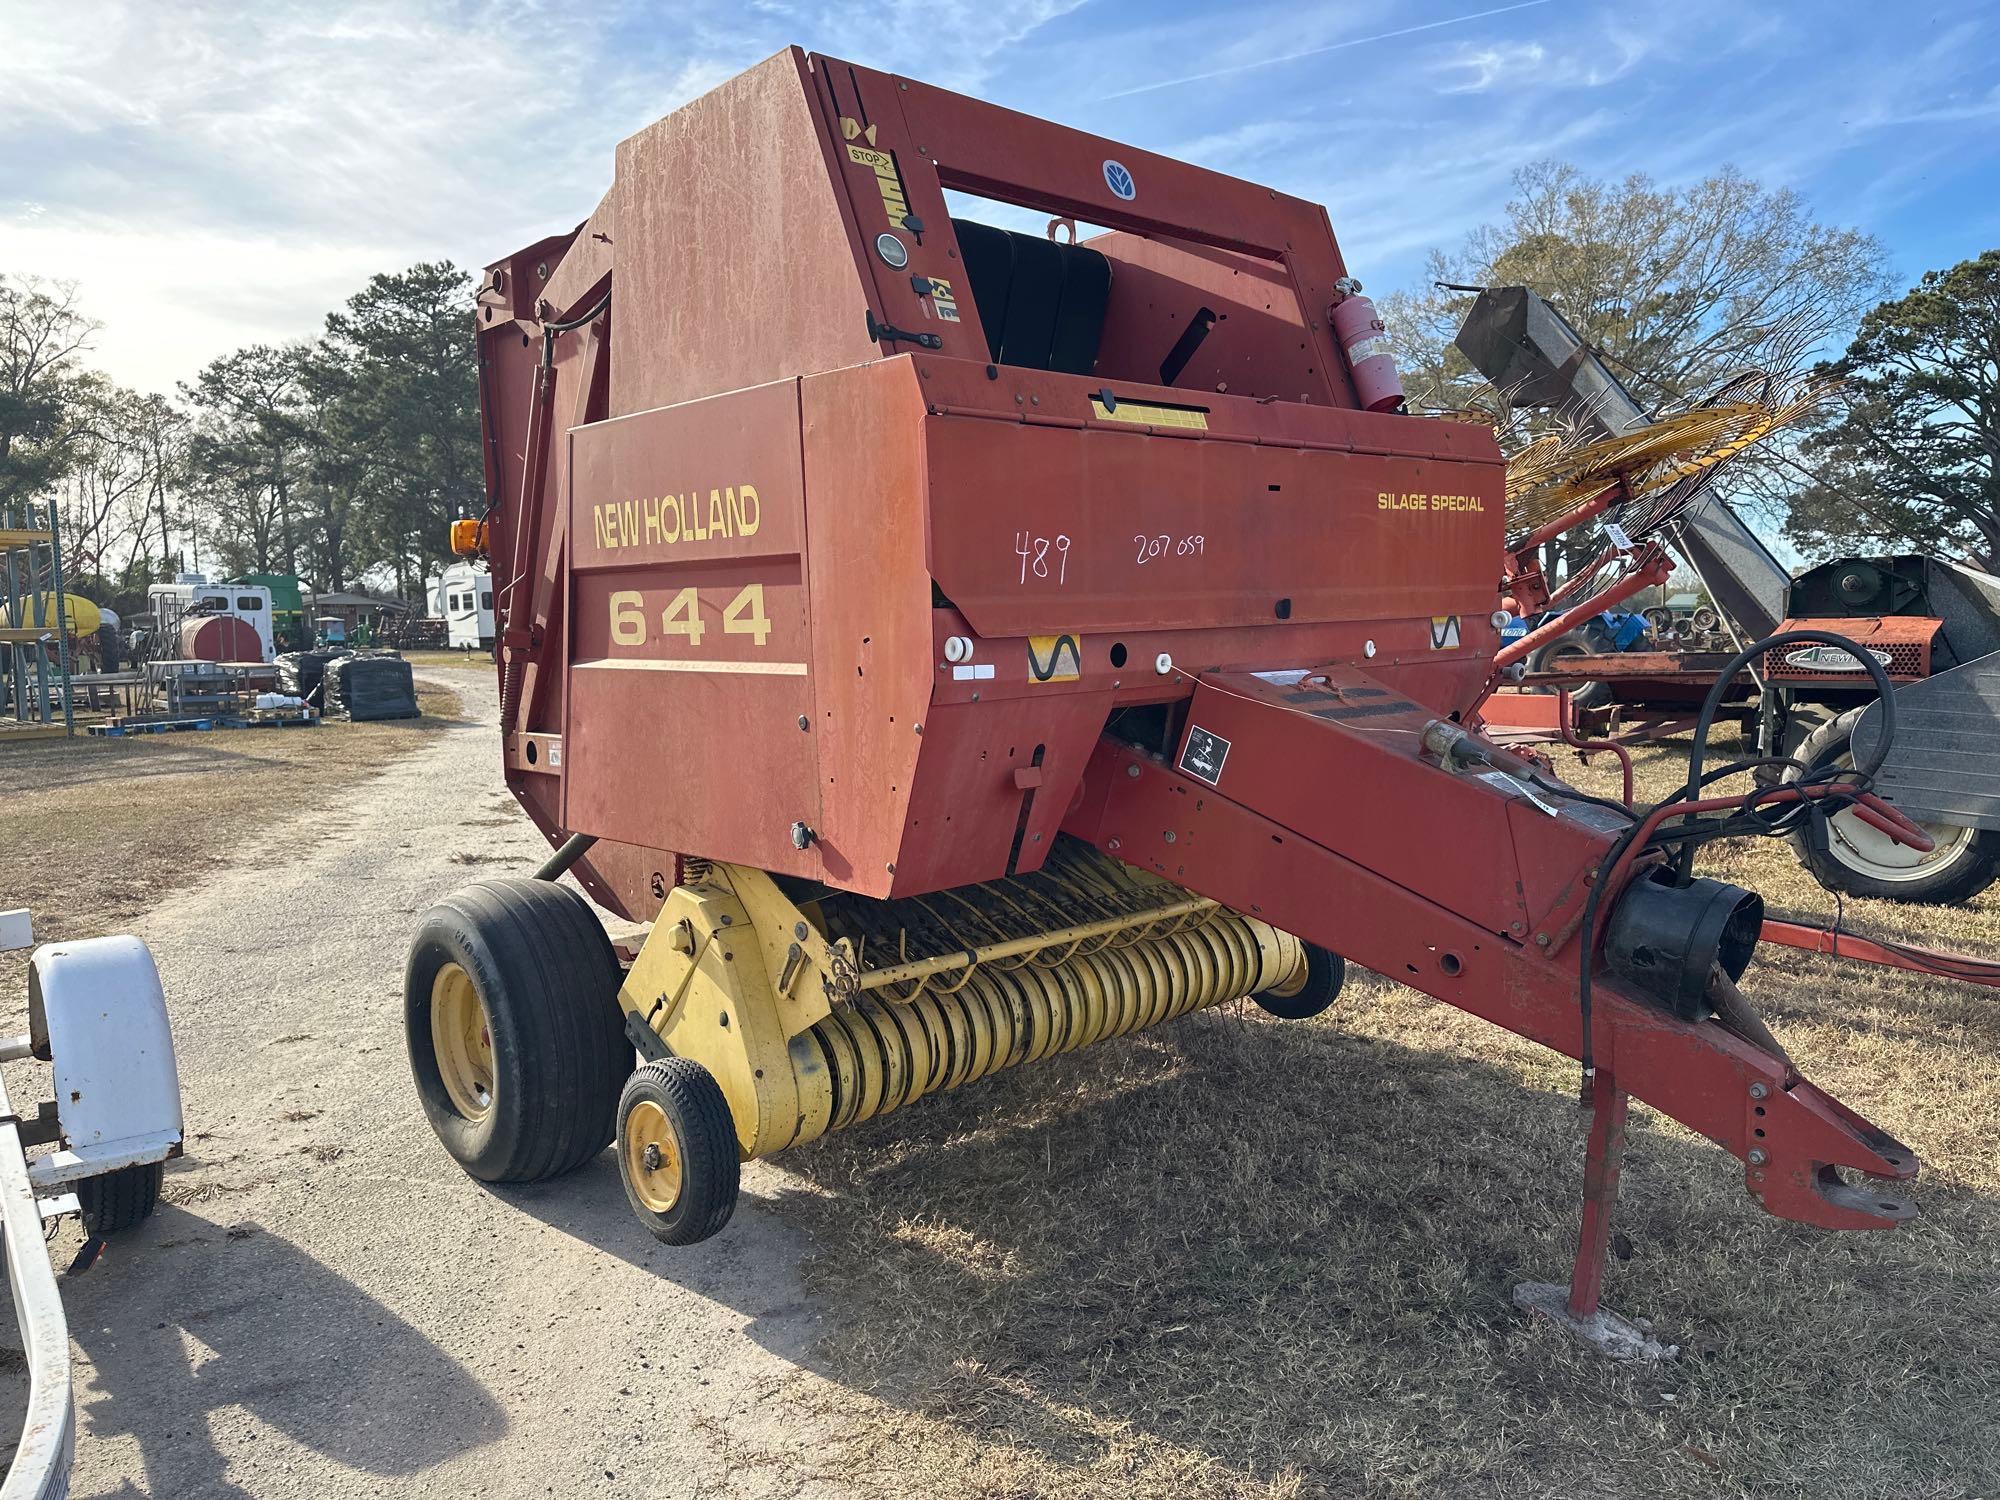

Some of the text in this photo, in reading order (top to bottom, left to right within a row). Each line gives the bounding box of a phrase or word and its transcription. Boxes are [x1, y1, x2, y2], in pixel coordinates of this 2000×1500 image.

[852, 149, 880, 163] STOP
[594, 484, 760, 549] NEW HOLLAND
[1378, 492, 1485, 512] SILAGE SPECIAL
[1015, 530, 1071, 585] 489
[609, 584, 771, 646] 644
[1821, 654, 1850, 662] NEW
